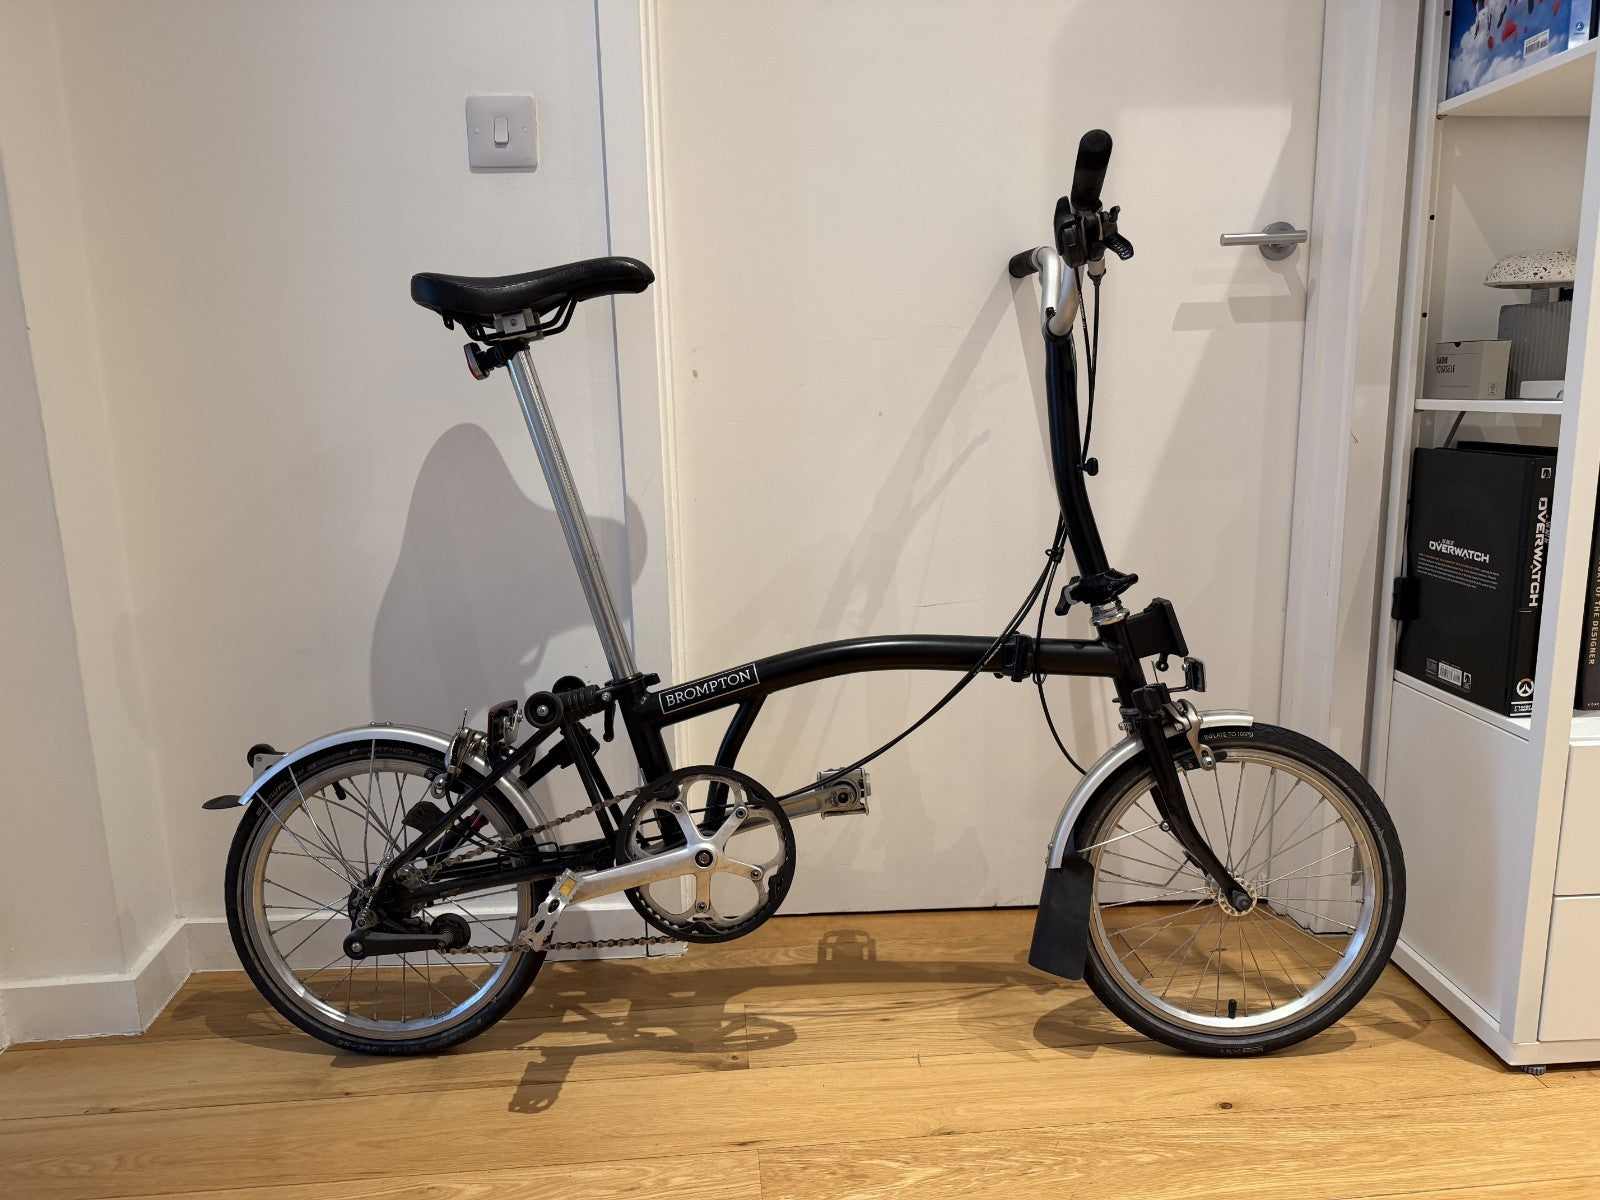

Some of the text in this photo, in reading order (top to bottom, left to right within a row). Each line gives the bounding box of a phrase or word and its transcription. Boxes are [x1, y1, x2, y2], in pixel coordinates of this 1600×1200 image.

[1428, 540, 1490, 564] OVERWATCH
[1528, 497, 1548, 608] OVERWATCH
[1588, 620, 1599, 665] DESIGNER
[665, 669, 751, 707] BROMPTON
